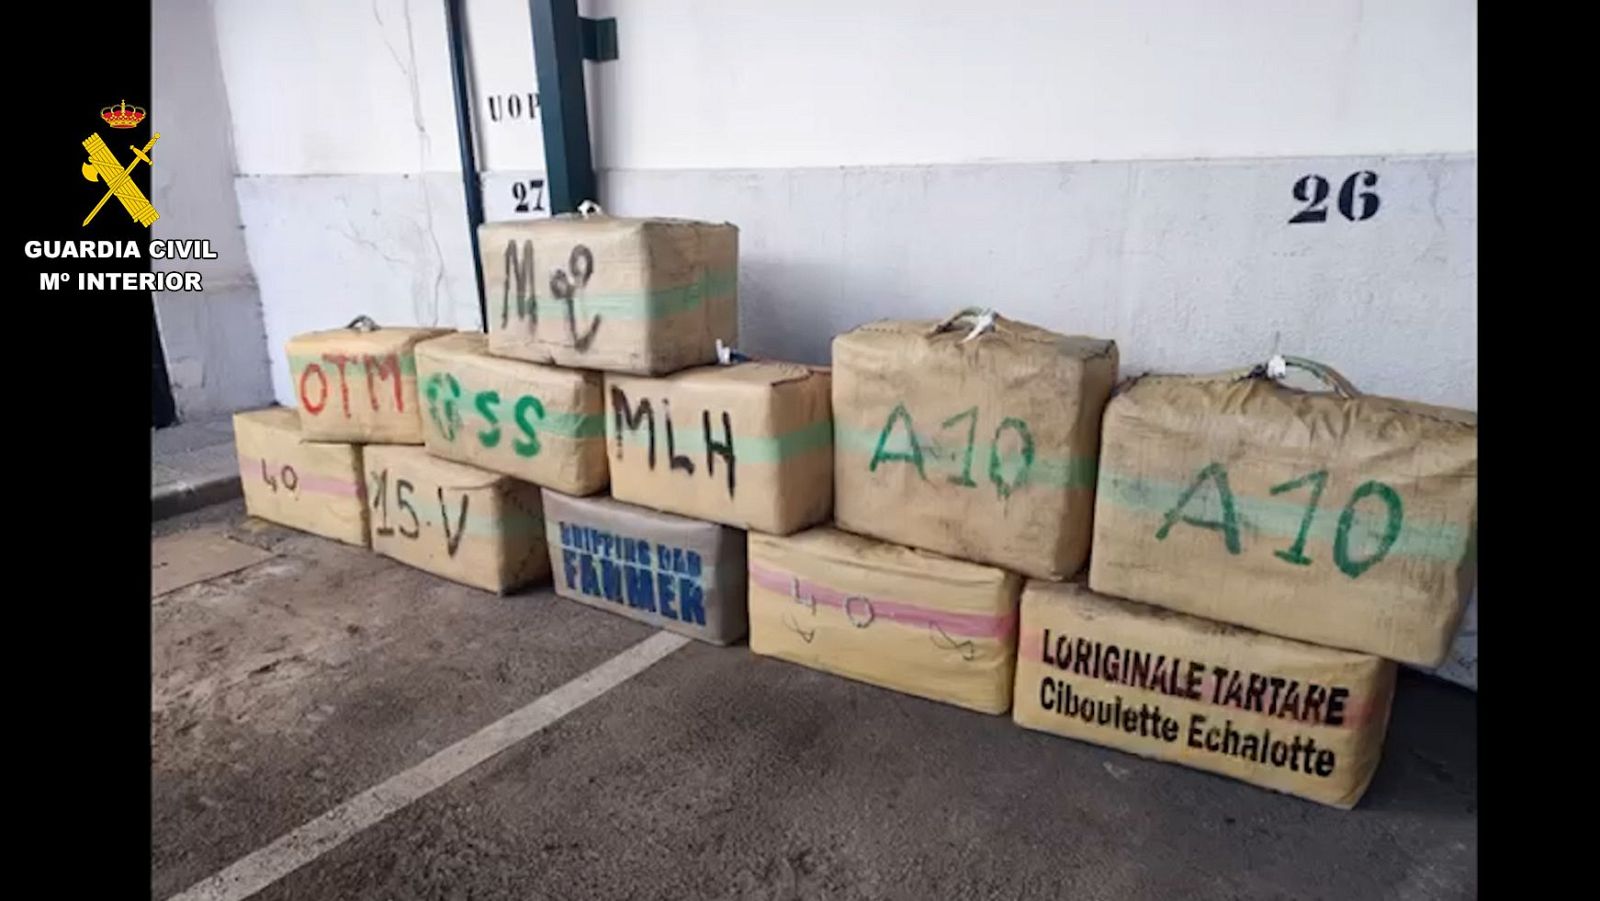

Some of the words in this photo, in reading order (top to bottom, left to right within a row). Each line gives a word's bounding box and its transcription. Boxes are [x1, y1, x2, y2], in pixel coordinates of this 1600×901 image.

[512, 180, 544, 212] 27
[1288, 170, 1380, 224] 26
[301, 353, 404, 419] OTM
[611, 384, 736, 502] MLH
[1042, 628, 1206, 701] LORIGINALE
[1212, 666, 1349, 726] TARTARE
[1040, 676, 1180, 742] Ciboulette
[1187, 713, 1335, 778] Echalotte
